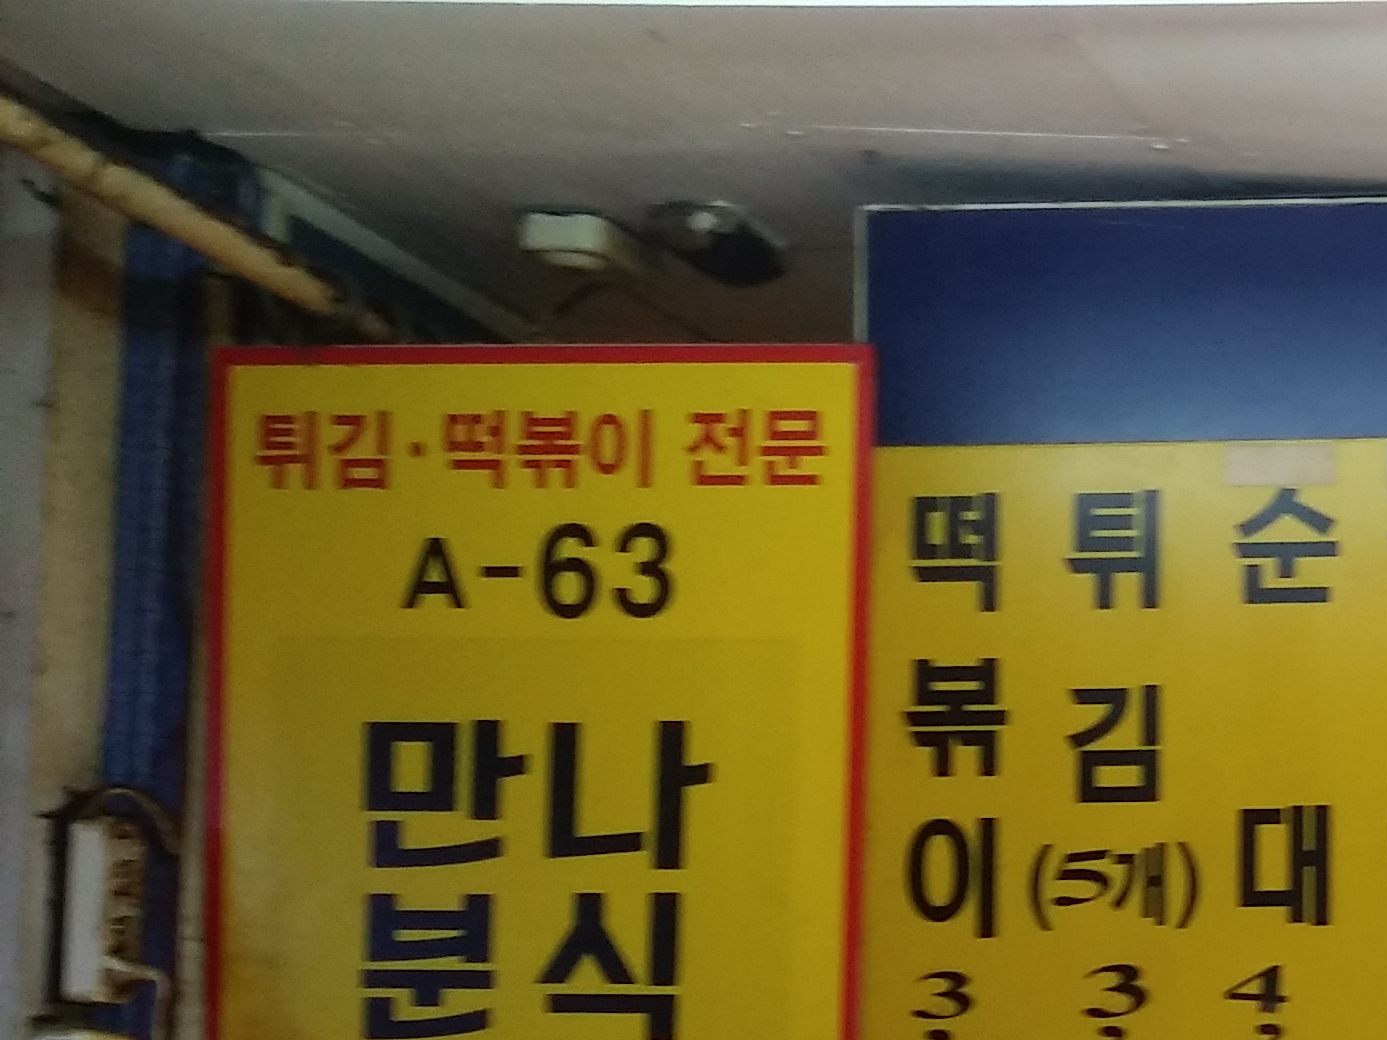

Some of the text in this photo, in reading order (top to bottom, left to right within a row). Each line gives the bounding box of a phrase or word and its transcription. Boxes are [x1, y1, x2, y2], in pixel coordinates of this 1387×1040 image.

[684, 407, 828, 487] 전문
[399, 522, 676, 620] A-63
[903, 491, 1010, 938] 떡볶이
[1025, 489, 1199, 930] 튀김 (5개)
[363, 719, 715, 871] 만나
